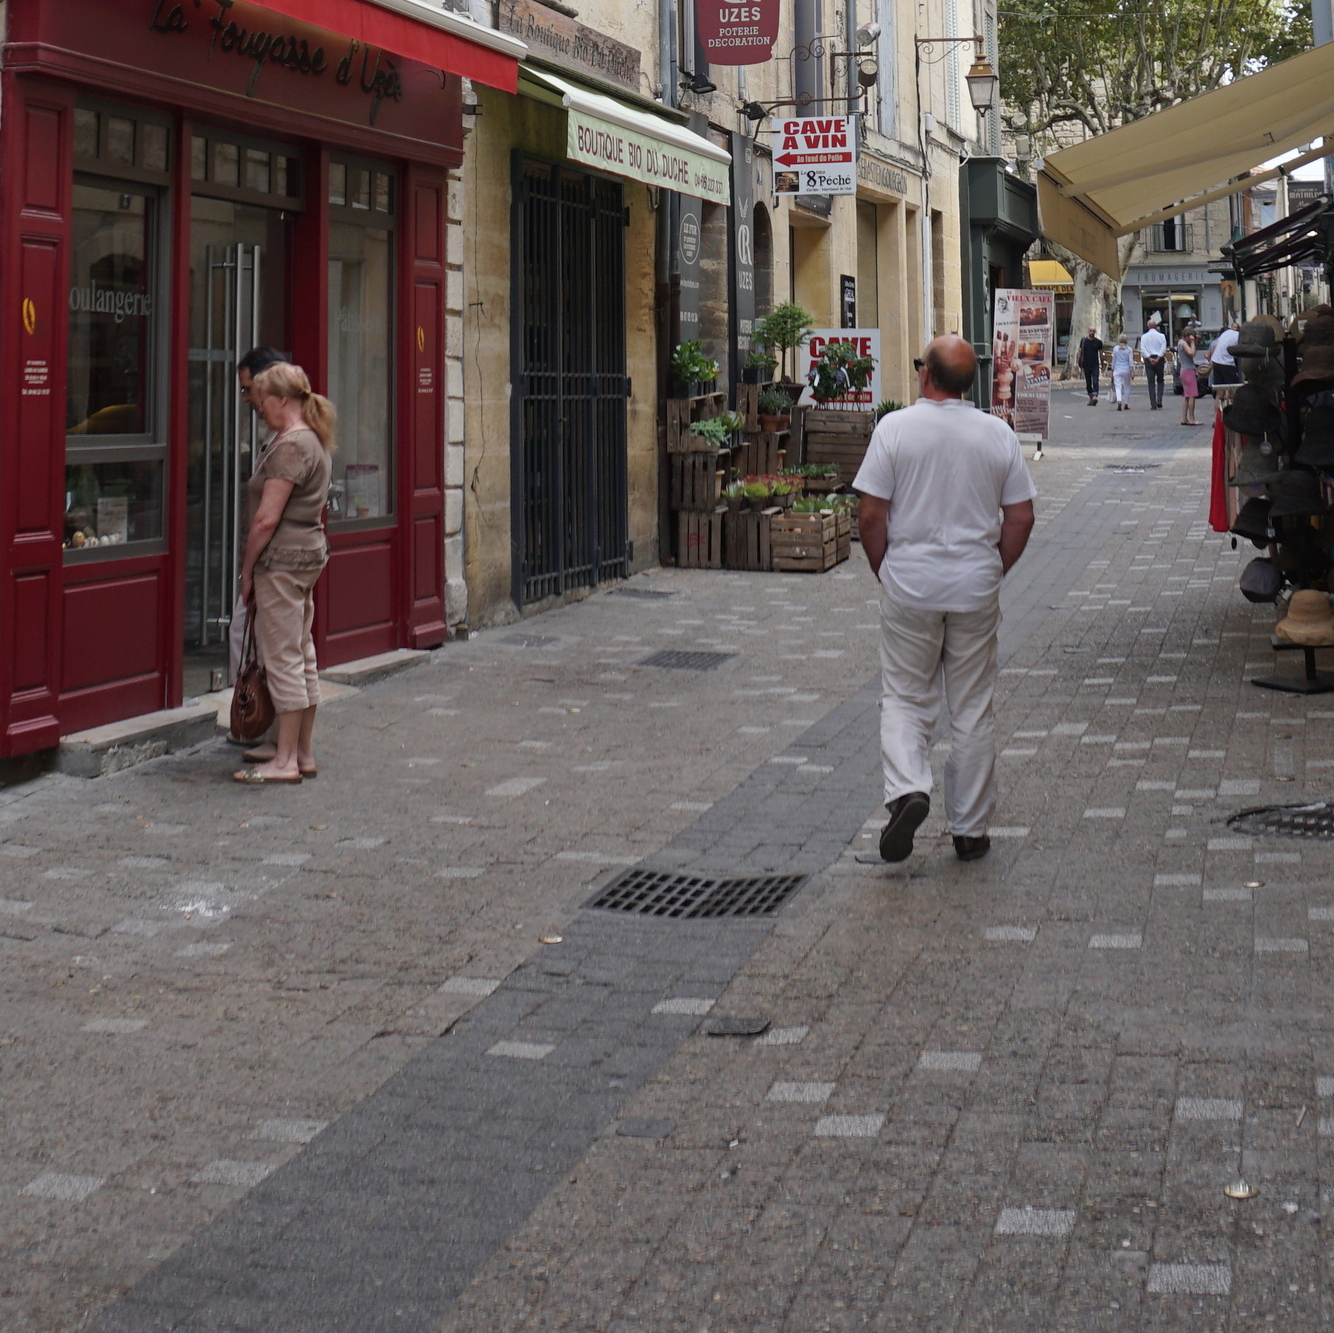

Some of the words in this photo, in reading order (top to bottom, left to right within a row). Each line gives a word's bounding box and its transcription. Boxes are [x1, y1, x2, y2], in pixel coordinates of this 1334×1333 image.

[719, 7, 761, 23] UZES
[526, 13, 570, 57] Boutique
[719, 26, 759, 37] POTERIE
[708, 36, 771, 47] DECORATION
[783, 119, 846, 135] CAVE
[782, 136, 799, 150] A
[804, 134, 847, 149] VIN
[577, 125, 624, 163] BOUTIQUE
[628, 142, 642, 169] BIO
[646, 149, 659, 175] DU
[662, 154, 689, 184] DUCHE
[738, 270, 753, 290] UZES
[1137, 272, 1205, 281] FROMAGERIE
[69, 279, 151, 323] oulangerie
